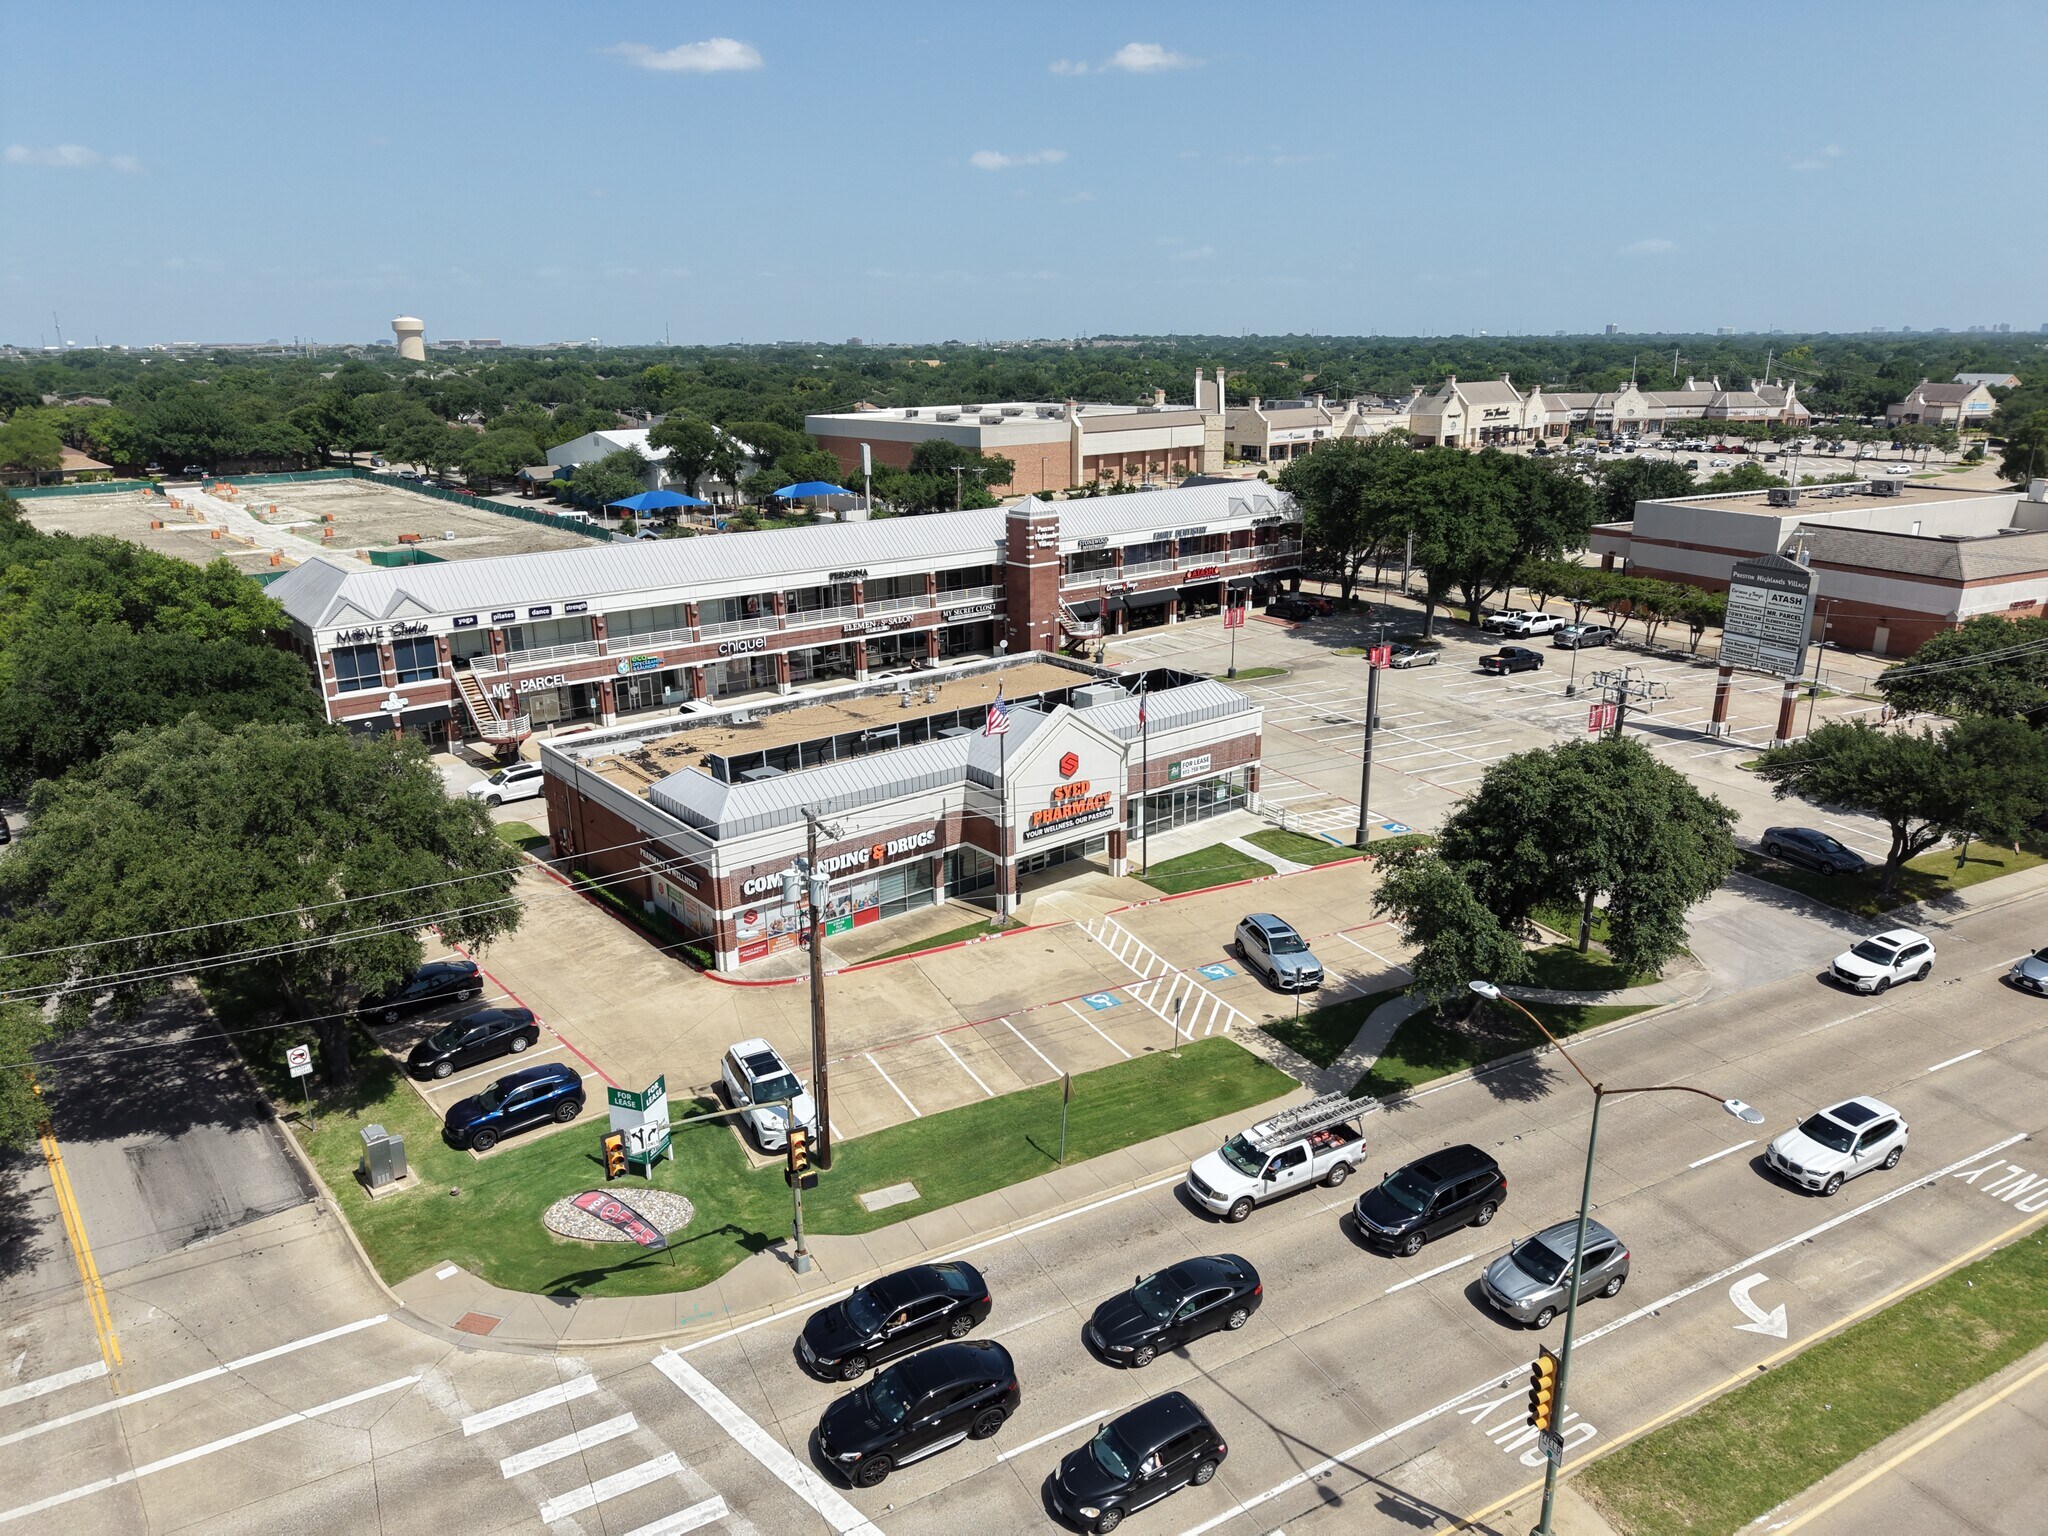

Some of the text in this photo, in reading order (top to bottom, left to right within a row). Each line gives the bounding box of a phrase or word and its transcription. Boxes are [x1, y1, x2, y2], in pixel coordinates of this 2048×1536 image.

[829, 568, 868, 580] PERSONA
[1192, 567, 1214, 577] ATASH
[1771, 594, 1803, 606] ATASH
[531, 607, 550, 616] dance
[565, 602, 588, 612] strength
[943, 608, 952, 618] MY
[953, 606, 975, 616] SECRET
[976, 603, 996, 612] CLOSET
[1741, 605, 1762, 614] Pharmacy
[458, 617, 474, 626] yoga
[493, 611, 514, 622] pilates
[888, 614, 914, 626] SALON
[1743, 613, 1762, 621] TAILOR
[1766, 618, 1786, 626] ELEMENTS
[1779, 612, 1802, 621] PARCEL
[719, 635, 767, 653] chiquel
[1763, 632, 1798, 644] Family Dentistry
[1725, 647, 1754, 658] Stonewood
[520, 674, 569, 691] PARCEL
[1183, 756, 1210, 769] FOR LEASE
[1054, 780, 1091, 801] SYED
[1033, 791, 1112, 826] PHARMACY
[1025, 828, 1043, 839] YOUR
[1075, 815, 1088, 826] OUR
[1088, 808, 1113, 821] PASSION
[743, 830, 936, 896] COMNDING & DRUGS
[672, 869, 698, 891] WELLNESS
[647, 1082, 660, 1096] FOR
[617, 1092, 632, 1100] FOR
[646, 1087, 663, 1107] LEASE
[614, 1098, 636, 1108] LEASE
[1953, 1159, 2048, 1213] ONLY
[1542, 1433, 1561, 1454] YIELD
